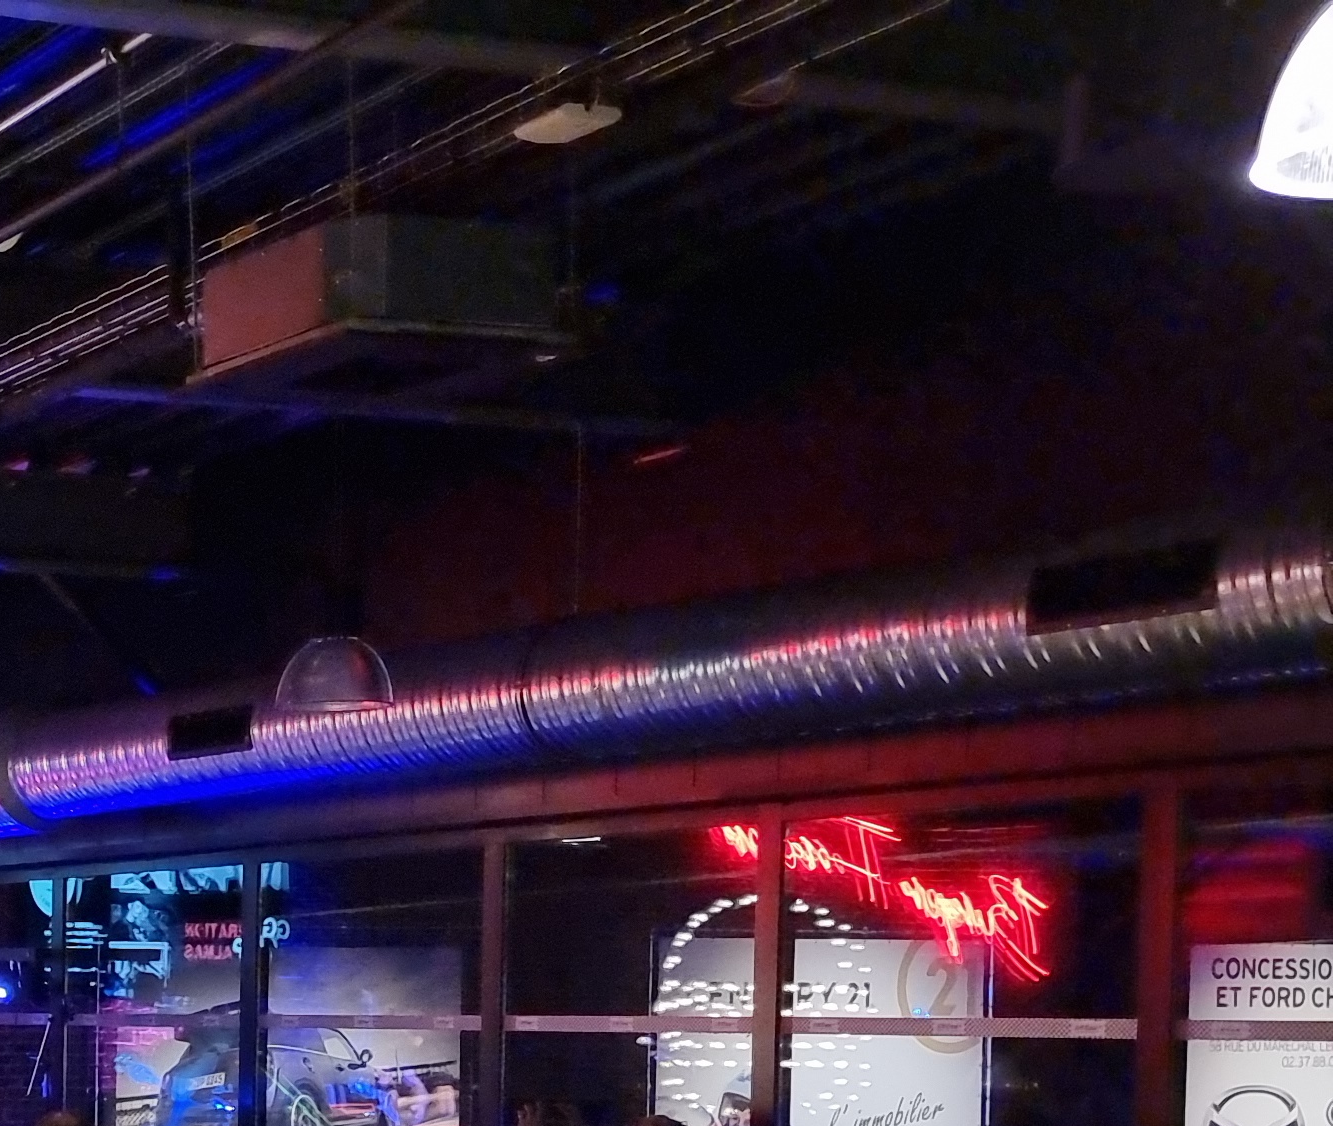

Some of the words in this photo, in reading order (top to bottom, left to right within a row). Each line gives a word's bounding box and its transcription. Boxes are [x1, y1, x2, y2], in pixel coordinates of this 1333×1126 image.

[1211, 957, 1333, 980] CONCESSIO
[1216, 986, 1242, 1008] ET
[1249, 986, 1306, 1008] FORD
[1312, 986, 1333, 1008] CH
